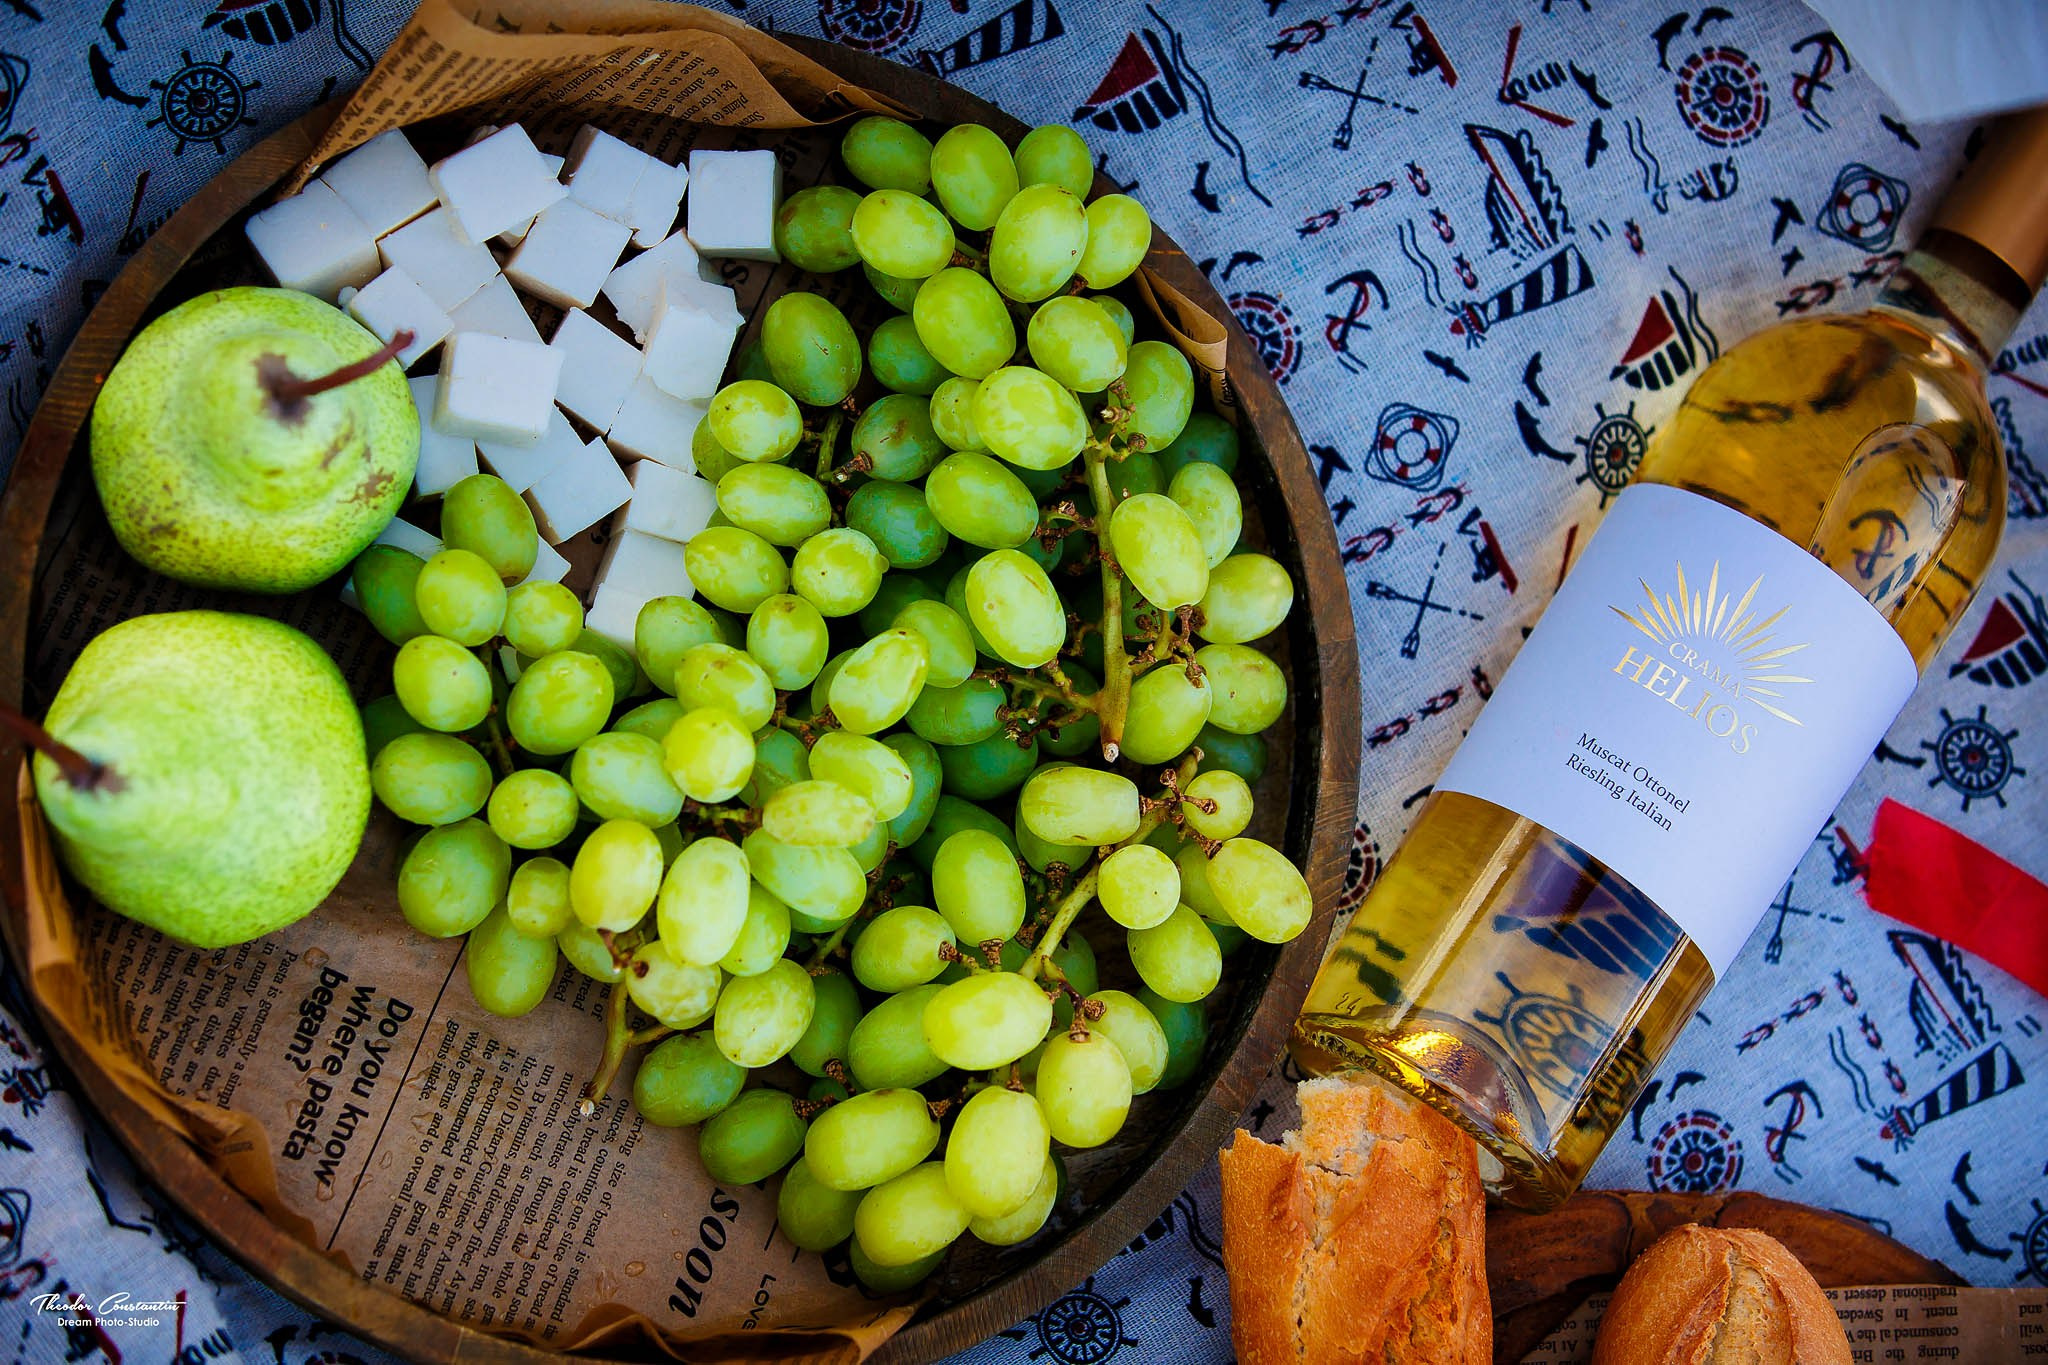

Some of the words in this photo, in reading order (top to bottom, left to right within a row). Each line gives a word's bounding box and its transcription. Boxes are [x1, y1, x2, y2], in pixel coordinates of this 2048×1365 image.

[626, 49, 672, 91] somewhat
[661, 50, 690, 73] Plant
[680, 56, 705, 75] time
[702, 66, 719, 78] es,
[595, 83, 605, 92] a
[604, 71, 624, 89] and
[649, 76, 663, 86] in
[668, 76, 681, 86] to
[672, 77, 706, 104] almost
[712, 87, 724, 98] it
[720, 79, 736, 92] be
[632, 88, 653, 104] full
[643, 87, 670, 113] plant
[698, 94, 716, 109] for
[721, 92, 749, 116] plants
[711, 111, 722, 121] to
[1669, 642, 1740, 697] CRAMA
[1614, 645, 1759, 755] HELIOS
[1576, 732, 1632, 773] Muscat
[1633, 766, 1691, 814] Ottonel
[1565, 753, 1625, 800] Riesling
[1625, 789, 1672, 831] Italian
[124, 938, 137, 954] or
[137, 944, 158, 977] sizes
[262, 941, 278, 956] in
[114, 954, 133, 984] food
[149, 943, 184, 995] lunches,
[183, 952, 201, 978] and
[204, 967, 220, 981] in
[242, 959, 268, 998] many
[272, 949, 298, 985] Pasta
[129, 977, 145, 999] for
[159, 978, 190, 1024] simple.
[188, 982, 214, 1014] Italy
[215, 973, 238, 1009] pasta
[266, 985, 283, 999] is
[136, 1004, 154, 1034] such
[282, 966, 349, 1073] began?
[378, 997, 415, 1038] Do
[590, 1003, 604, 1022] of
[146, 1026, 170, 1061] Pasta
[166, 1014, 199, 1066] because
[194, 1014, 222, 1056] dishes
[216, 1006, 248, 1059] varieties
[320, 985, 377, 1076] where
[436, 1019, 460, 1060] grains
[455, 1031, 480, 1070] whole
[482, 1038, 500, 1060] the
[505, 1046, 520, 1060] it
[182, 1061, 198, 1083] are
[201, 1066, 222, 1092] due
[233, 1062, 245, 1071] a
[350, 1039, 390, 1099] you
[418, 1060, 447, 1101] intake.
[498, 1059, 514, 1073] is
[520, 1056, 538, 1077] the
[534, 1064, 554, 1088] um,
[216, 1072, 242, 1111] simpl
[438, 1068, 462, 1110] grains
[506, 1077, 529, 1111] 2010
[531, 1090, 546, 1104] B
[543, 1071, 574, 1129] nutrients
[281, 1077, 333, 1161] pasta
[440, 1066, 486, 1158] recommended
[459, 1074, 505, 1166] recommended
[587, 1092, 613, 1123] Also,
[601, 1098, 630, 1144] ounces,
[426, 1112, 444, 1139] and
[483, 1110, 515, 1161] Dietary
[504, 1106, 538, 1160] vitamins,
[312, 1102, 369, 1188] know
[419, 1139, 434, 1154] to
[527, 1131, 548, 1162] such
[573, 1127, 599, 1165] bread
[397, 1156, 425, 1203] overall
[423, 1164, 446, 1196] total
[452, 1166, 467, 1180] to
[494, 1163, 511, 1190] and
[520, 1165, 533, 1181] as
[566, 1165, 582, 1179] is
[575, 1148, 609, 1205] counting
[607, 1161, 627, 1188] size
[435, 1182, 458, 1219] make
[454, 1161, 493, 1230] Guidelines
[522, 1176, 553, 1225] through
[599, 1191, 612, 1210] of
[404, 1200, 428, 1237] grain
[472, 1188, 503, 1234] dietary
[482, 1183, 525, 1259] magnesium,
[535, 1180, 572, 1251] considered
[567, 1205, 584, 1230] one
[372, 1203, 406, 1258] increase
[427, 1222, 440, 1237] at
[444, 1230, 462, 1252] for
[511, 1232, 529, 1254] the
[582, 1209, 608, 1248] bread
[412, 1237, 437, 1270] least
[458, 1234, 483, 1268] fiber.
[529, 1251, 541, 1261] a
[552, 1230, 574, 1262] slice
[574, 1250, 590, 1264] is
[667, 1186, 742, 1319] soon
[384, 1243, 411, 1285] intake
[468, 1263, 494, 1293] iron,
[545, 1263, 558, 1283] of
[449, 1269, 466, 1290] As
[491, 1261, 515, 1299] whole
[515, 1261, 536, 1298] good
[529, 1280, 555, 1318] bread
[550, 1267, 580, 1323] standard
[1844, 1289, 1885, 1302] dessert
[1895, 1308, 1907, 1320] In
[1921, 1306, 1957, 1319] ment.
[2019, 1304, 2042, 1317] and
[1856, 1329, 1875, 1343] the
[1894, 1326, 1958, 1342] consumed
[2019, 1324, 2043, 1337] will
[1885, 1349, 1904, 1361] the
[1918, 1344, 1958, 1360] during
